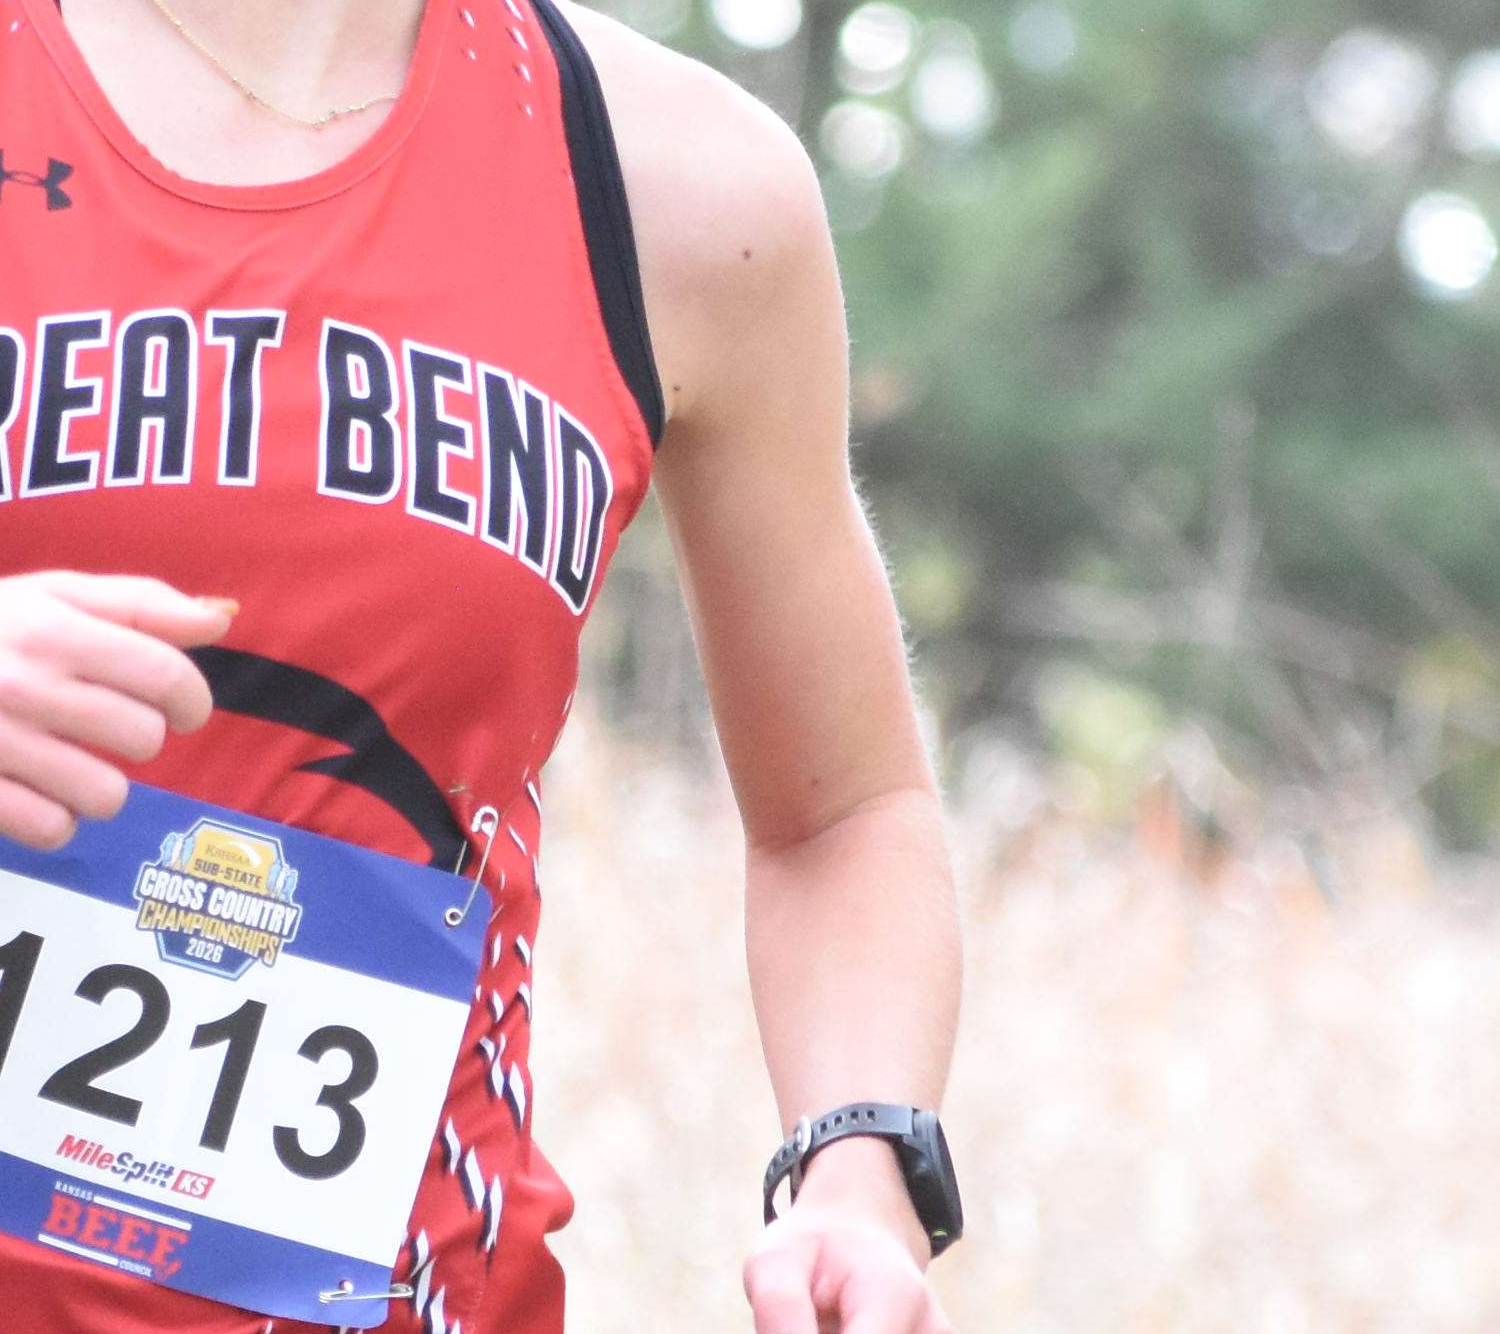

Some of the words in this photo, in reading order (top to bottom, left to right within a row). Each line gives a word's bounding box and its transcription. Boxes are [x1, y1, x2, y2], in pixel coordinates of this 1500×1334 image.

[317, 318, 614, 616] BEND
[139, 867, 208, 911] CROSS
[207, 886, 298, 936] COUNTRY
[193, 858, 263, 889] SUB-STATE
[138, 898, 280, 967] CHAMPIONSHIPS
[185, 937, 225, 964] 2026
[54, 1180, 94, 1202] KANSAS
[56, 1134, 176, 1188] MileSplit
[177, 1170, 211, 1197] KS
[43, 1192, 191, 1268] BEEF
